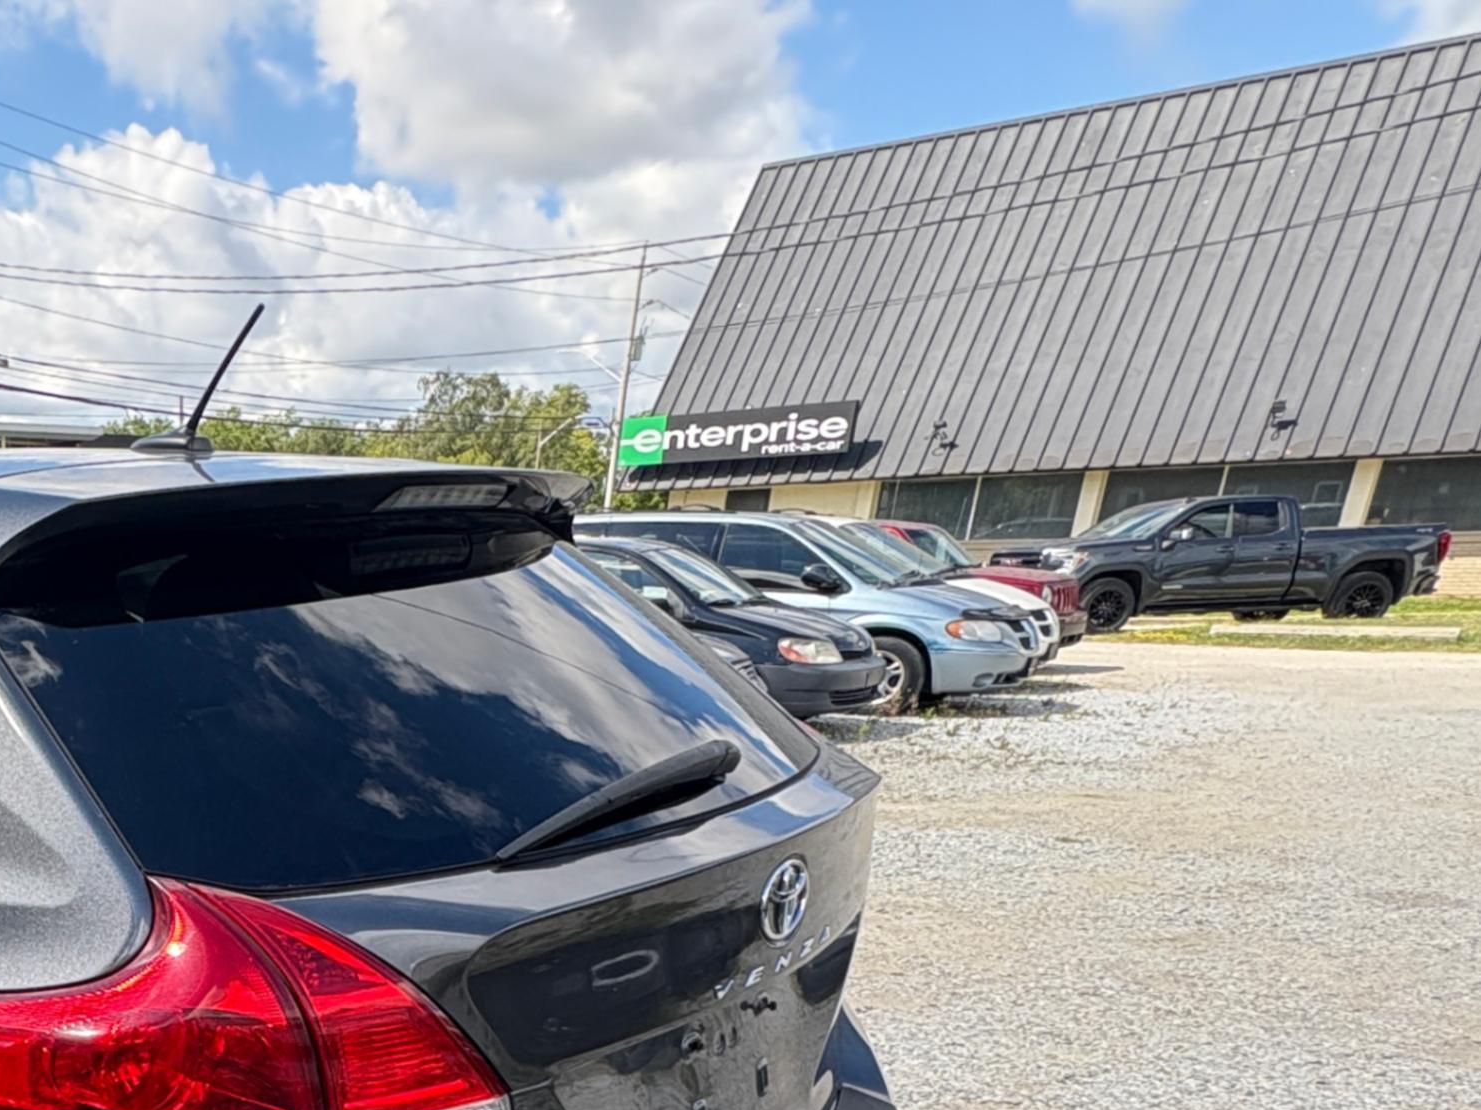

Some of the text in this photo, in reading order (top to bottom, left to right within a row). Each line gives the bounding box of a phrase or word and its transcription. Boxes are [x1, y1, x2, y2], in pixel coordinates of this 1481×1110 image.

[621, 412, 849, 453] enterprise
[761, 440, 844, 455] rent-a-car
[713, 925, 831, 1000] VENZA
